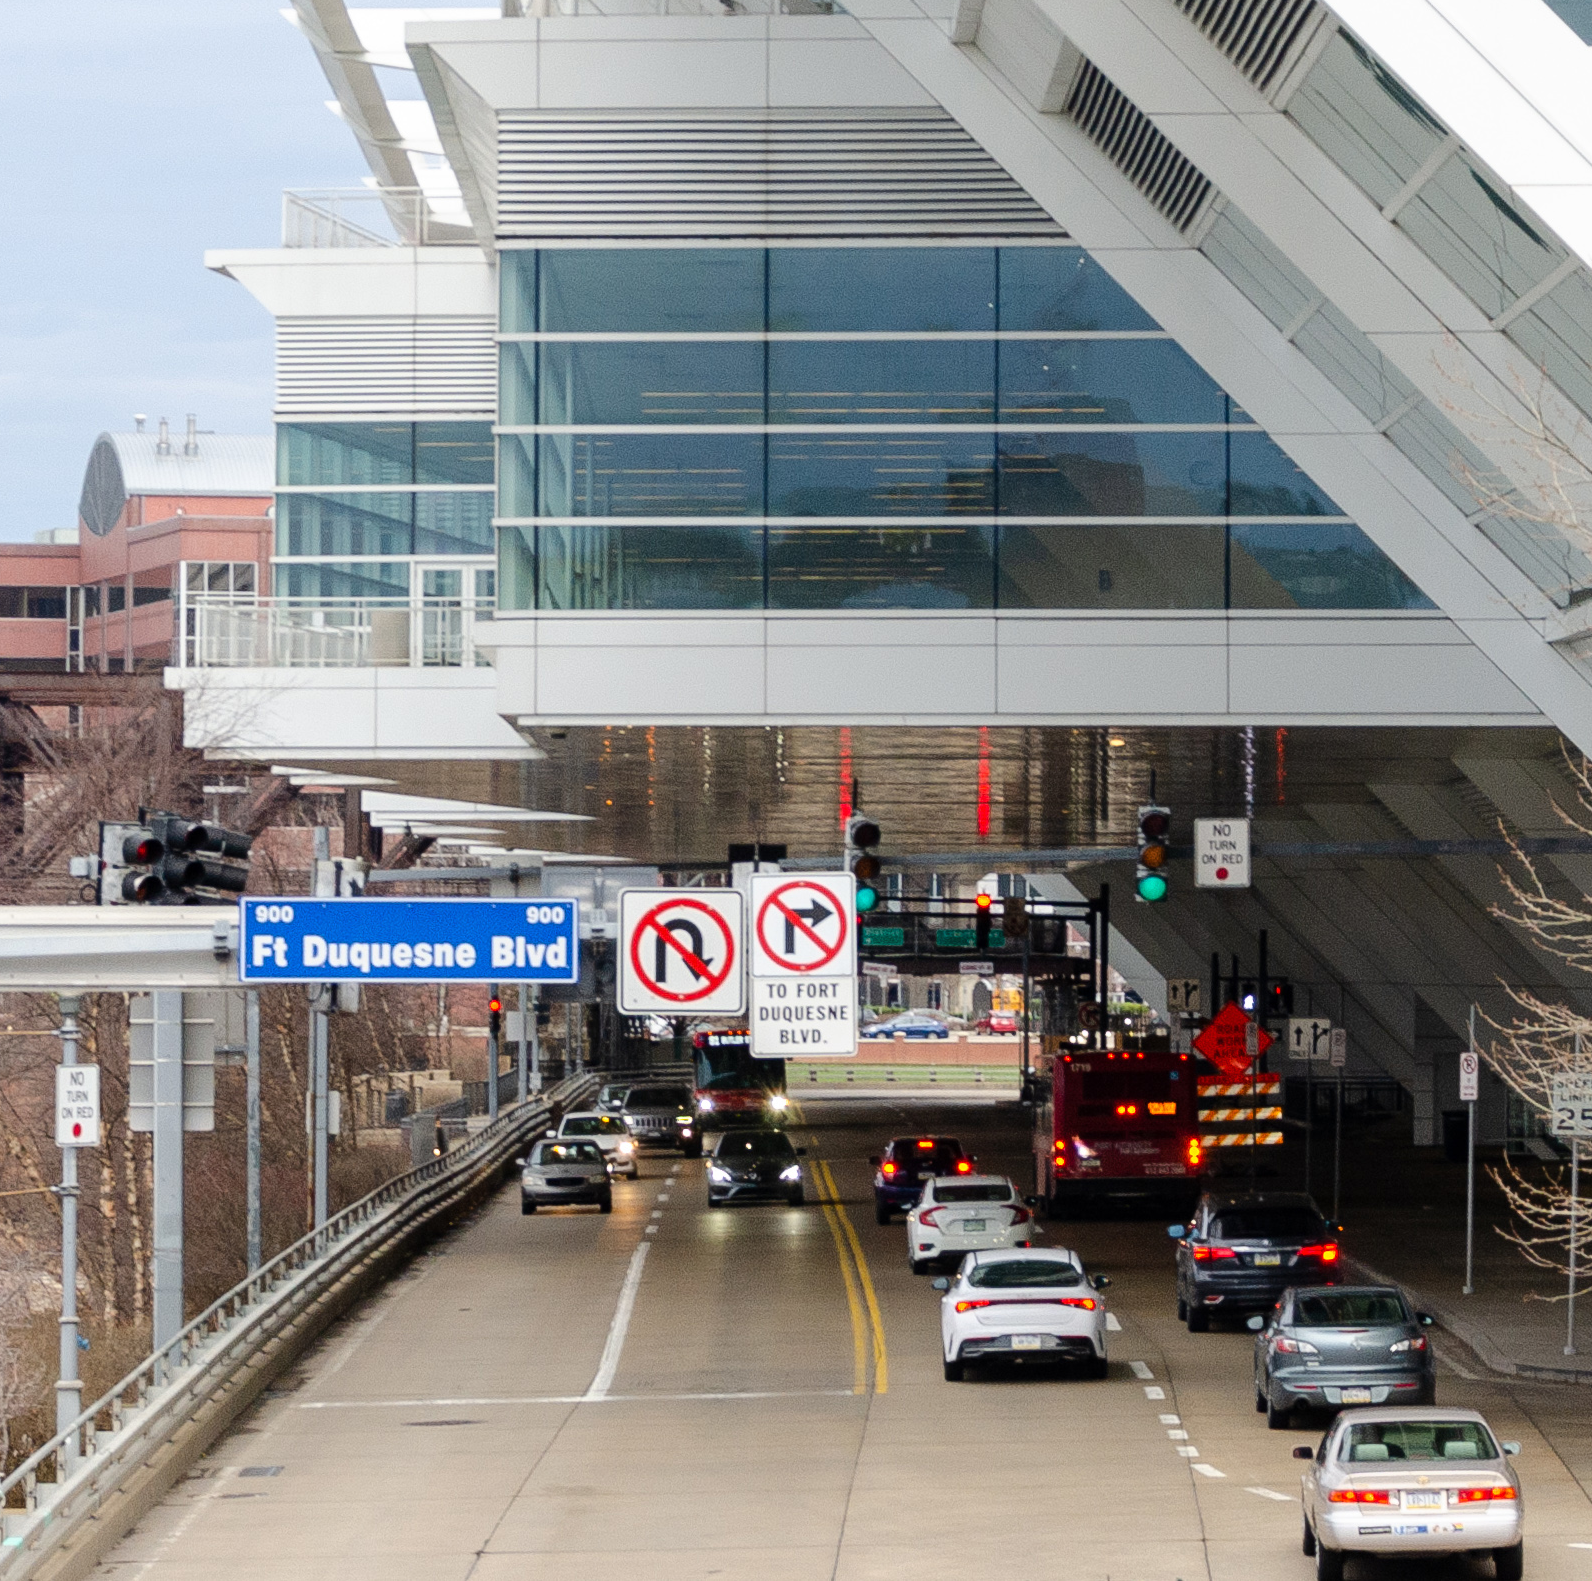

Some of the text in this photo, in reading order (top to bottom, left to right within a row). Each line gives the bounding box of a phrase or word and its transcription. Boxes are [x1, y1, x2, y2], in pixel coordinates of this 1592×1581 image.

[1212, 824, 1231, 837] NO
[1209, 840, 1237, 850] TURN
[1202, 854, 1243, 864] ON RED
[255, 905, 565, 924] 900 900
[252, 935, 567, 973] Ft Duquesne Blvd
[767, 983, 838, 998] TO FORT
[760, 1005, 849, 1022] DUQUESNE
[780, 1029, 828, 1044] BLVD.
[70, 1071, 84, 1085] NO
[67, 1090, 89, 1103] TURN
[62, 1106, 94, 1118] ON RED
